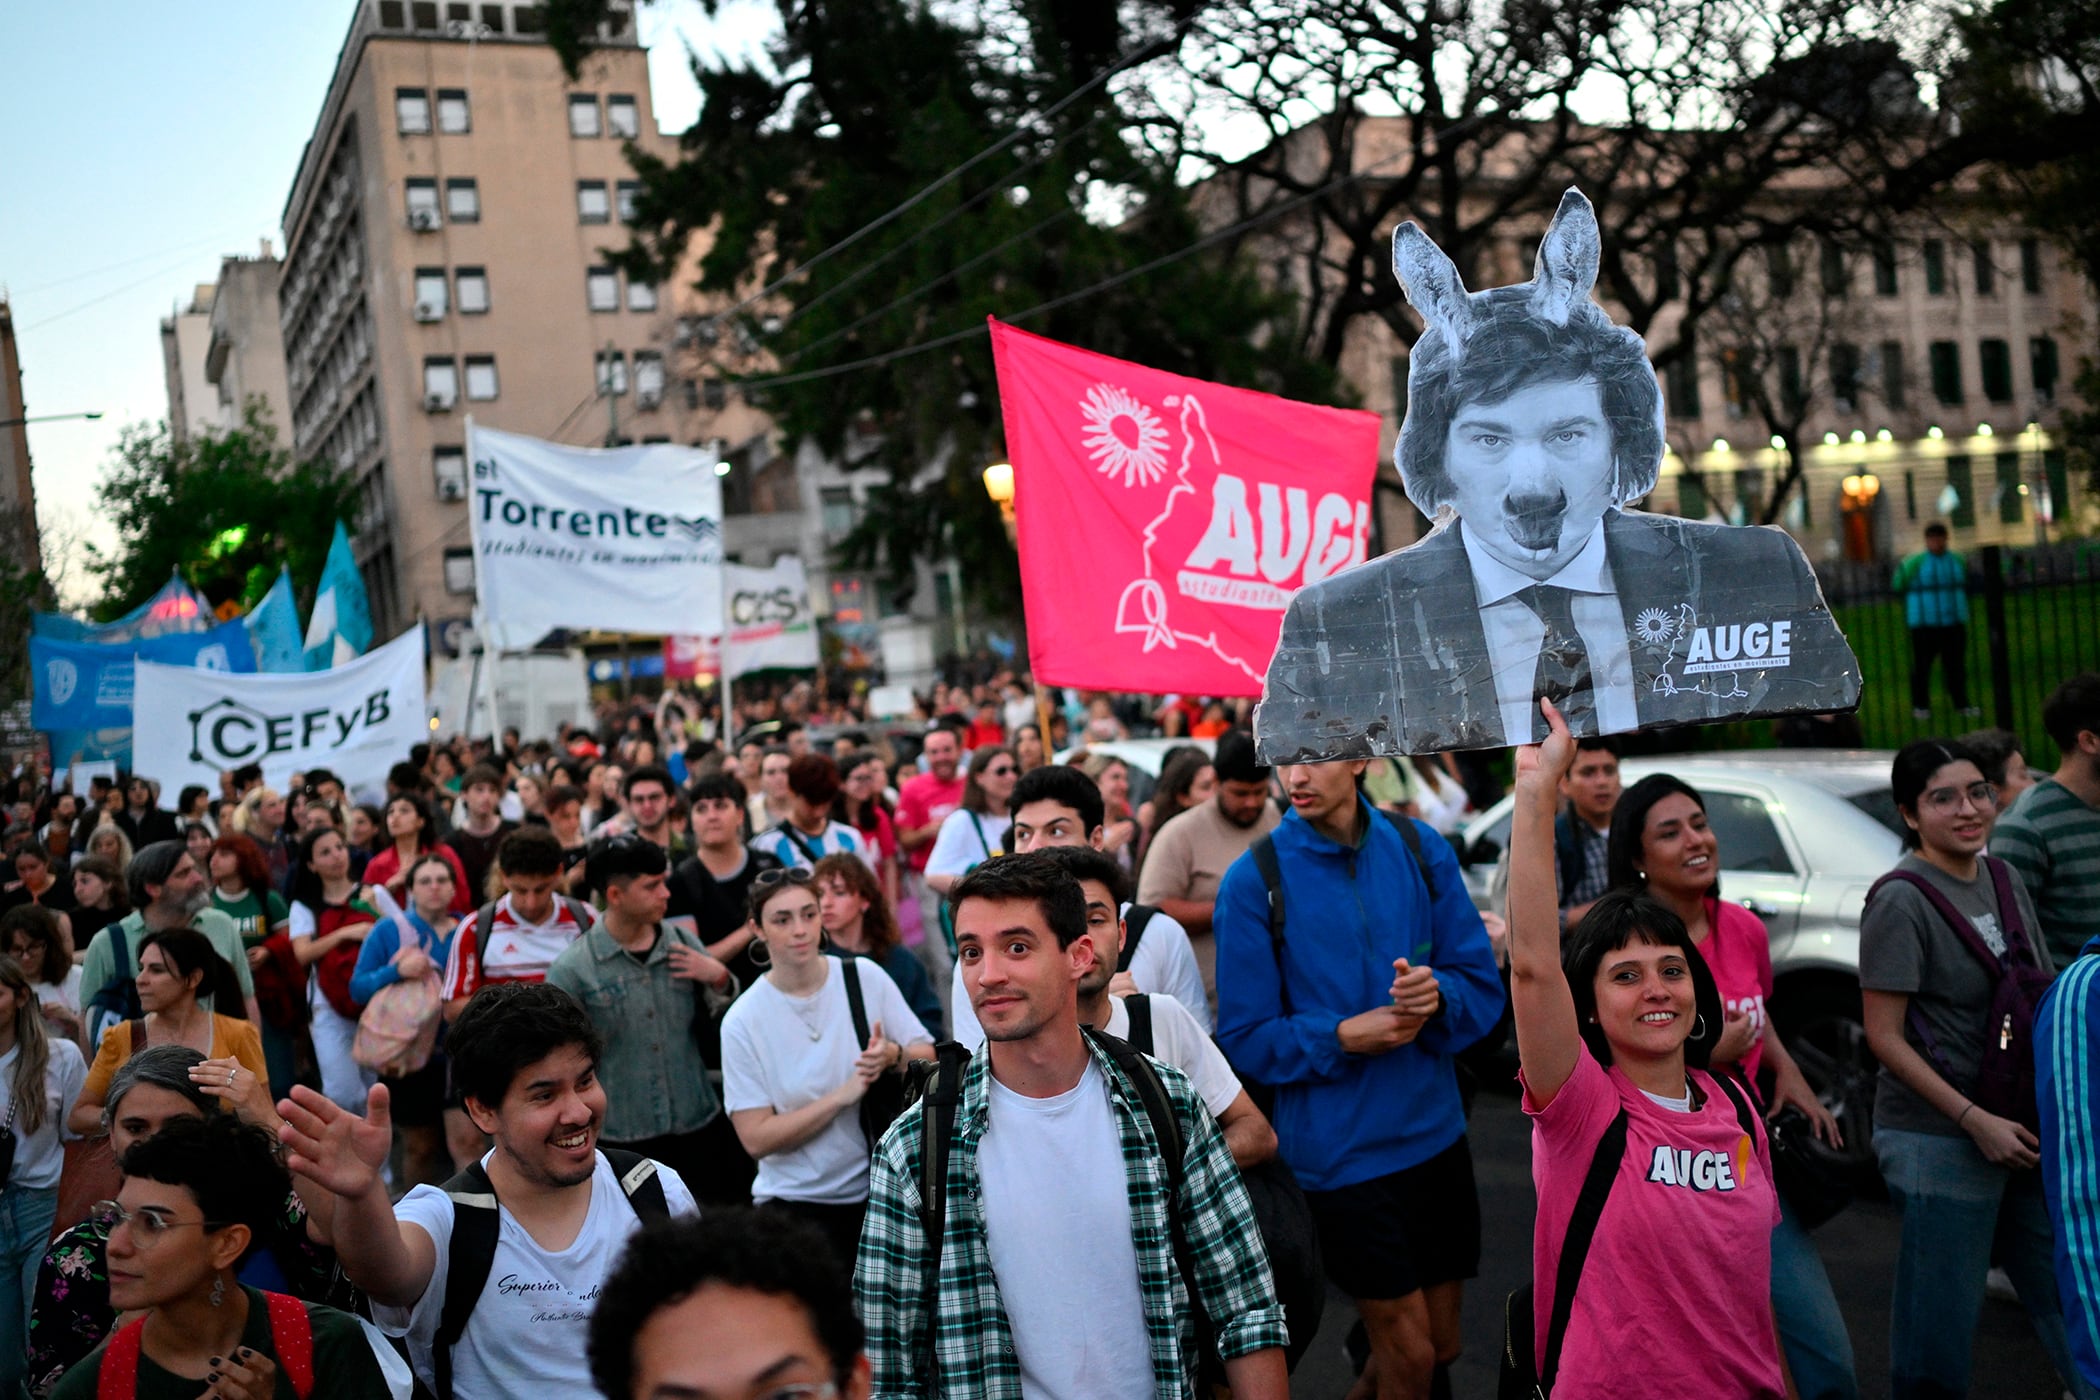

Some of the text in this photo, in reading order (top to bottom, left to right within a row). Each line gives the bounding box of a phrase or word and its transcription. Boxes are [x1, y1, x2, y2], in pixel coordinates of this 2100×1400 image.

[477, 489, 668, 538] Torrente
[1183, 578, 1284, 604] estudiantes
[1686, 620, 1792, 663] AUGE
[1689, 661, 1731, 672] estudiantes
[211, 689, 391, 758] CEFyB
[1648, 1145, 1736, 1192] AUGE
[497, 1273, 560, 1297] Superior
